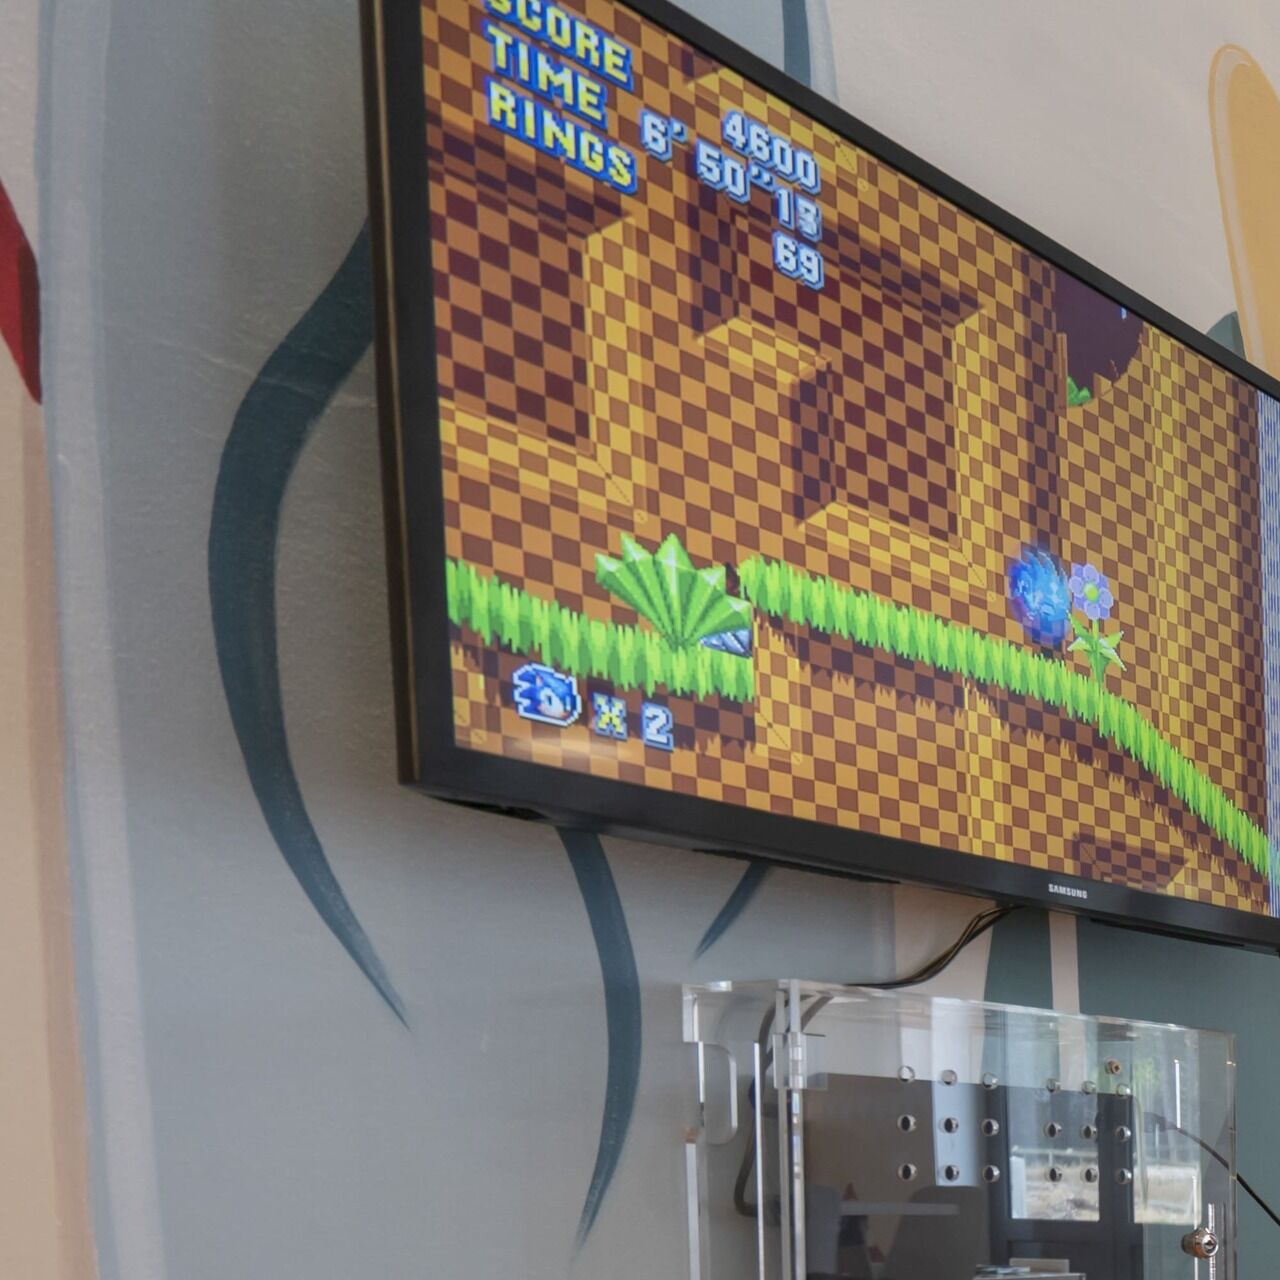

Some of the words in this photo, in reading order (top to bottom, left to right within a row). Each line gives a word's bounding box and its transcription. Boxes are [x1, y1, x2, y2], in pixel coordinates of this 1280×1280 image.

[482, 19, 608, 131] TIME
[485, 76, 638, 196] RINGS
[722, 110, 821, 195] 4600
[771, 229, 825, 290] 69
[642, 702, 673, 752] 2
[1048, 883, 1088, 899] SAMSUNG
